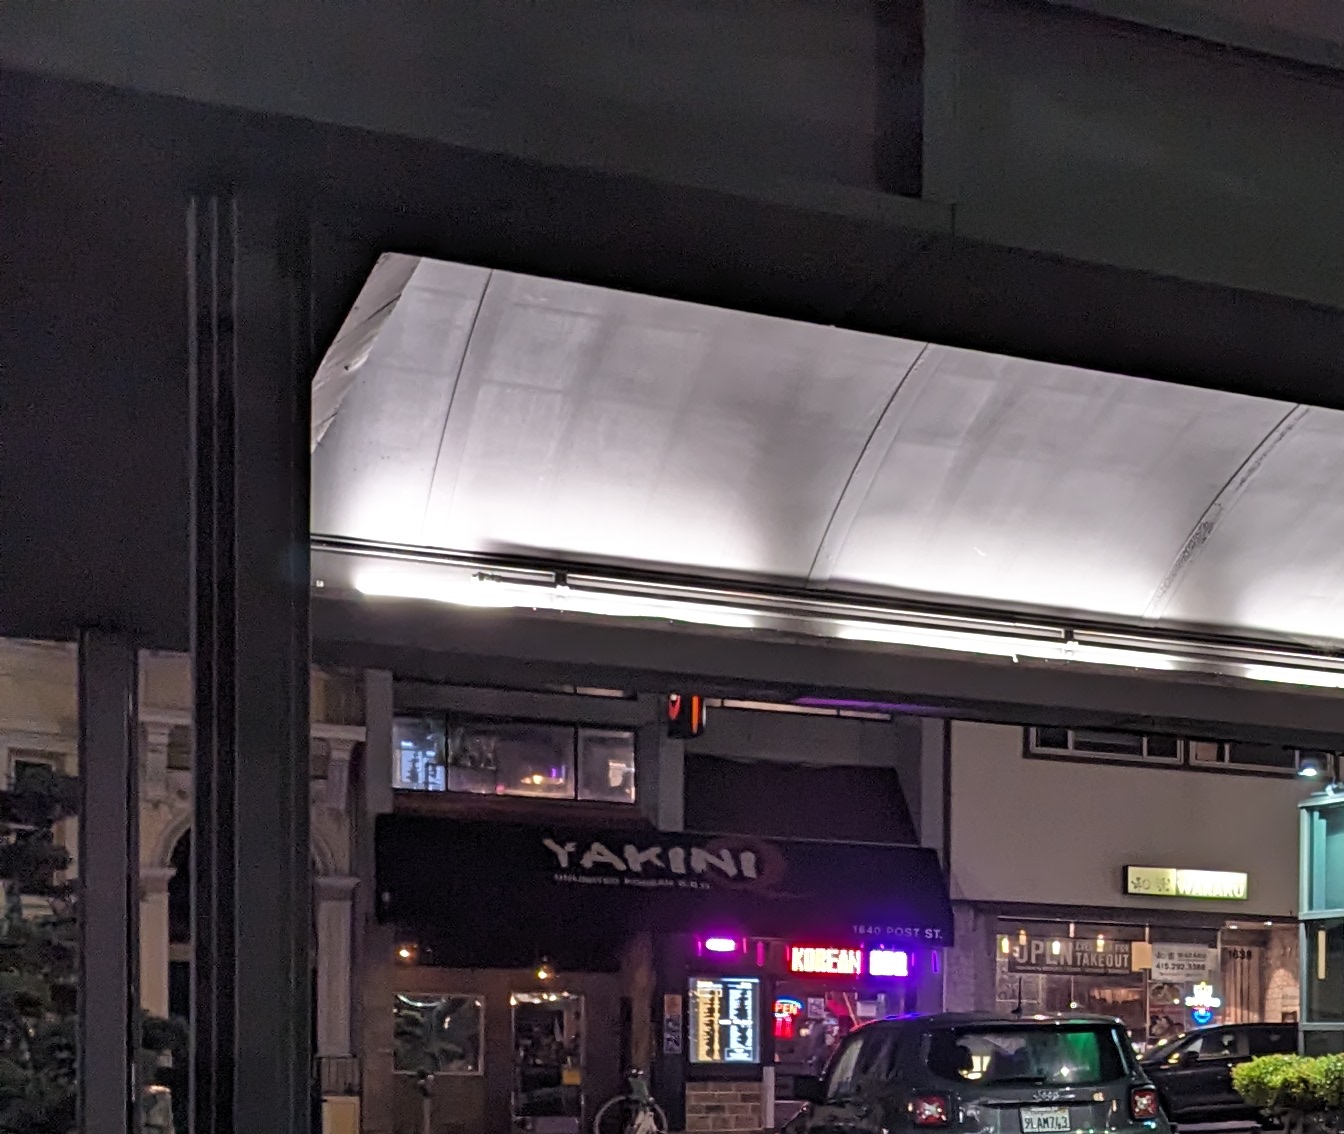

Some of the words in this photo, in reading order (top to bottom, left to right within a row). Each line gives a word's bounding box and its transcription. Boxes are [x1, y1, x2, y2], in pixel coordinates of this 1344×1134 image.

[542, 837, 758, 880] YAKINI
[886, 926, 920, 938] POST
[924, 928, 943, 940] ST.
[1014, 939, 1073, 965] OPEN
[1075, 951, 1130, 967] TAKEOUT
